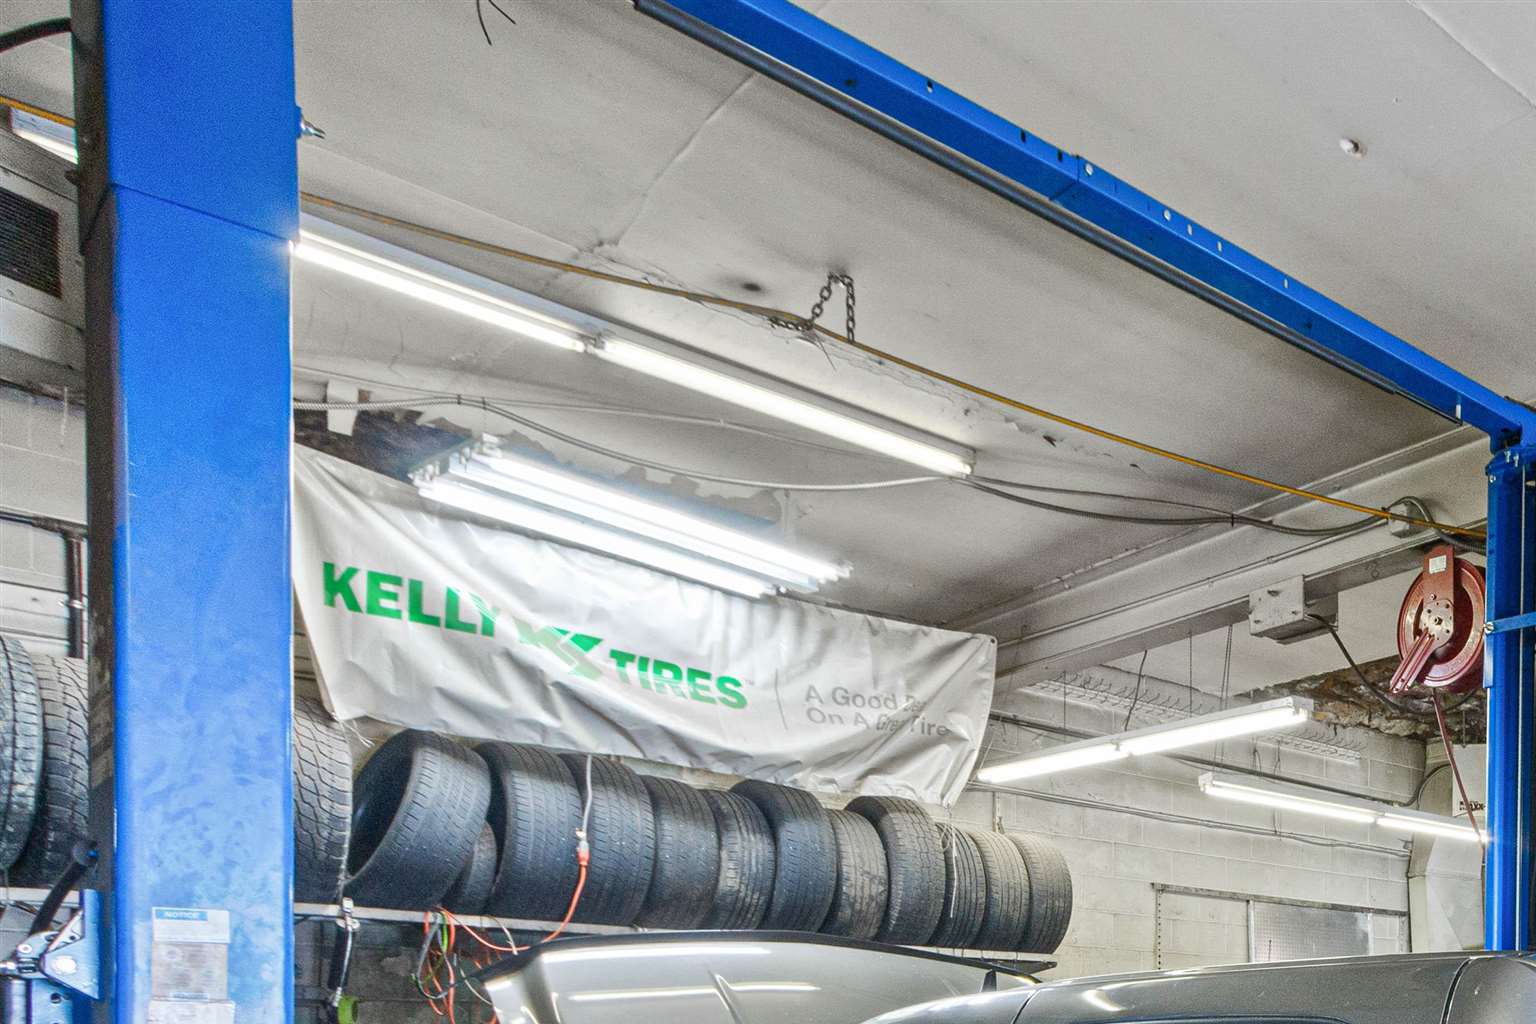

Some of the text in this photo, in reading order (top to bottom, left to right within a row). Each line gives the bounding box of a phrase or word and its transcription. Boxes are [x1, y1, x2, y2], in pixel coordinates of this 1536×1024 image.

[322, 560, 748, 709] KELLY TIRES
[805, 684, 824, 705] A
[831, 686, 898, 711] Good
[806, 707, 844, 725] On
[853, 711, 871, 729] A
